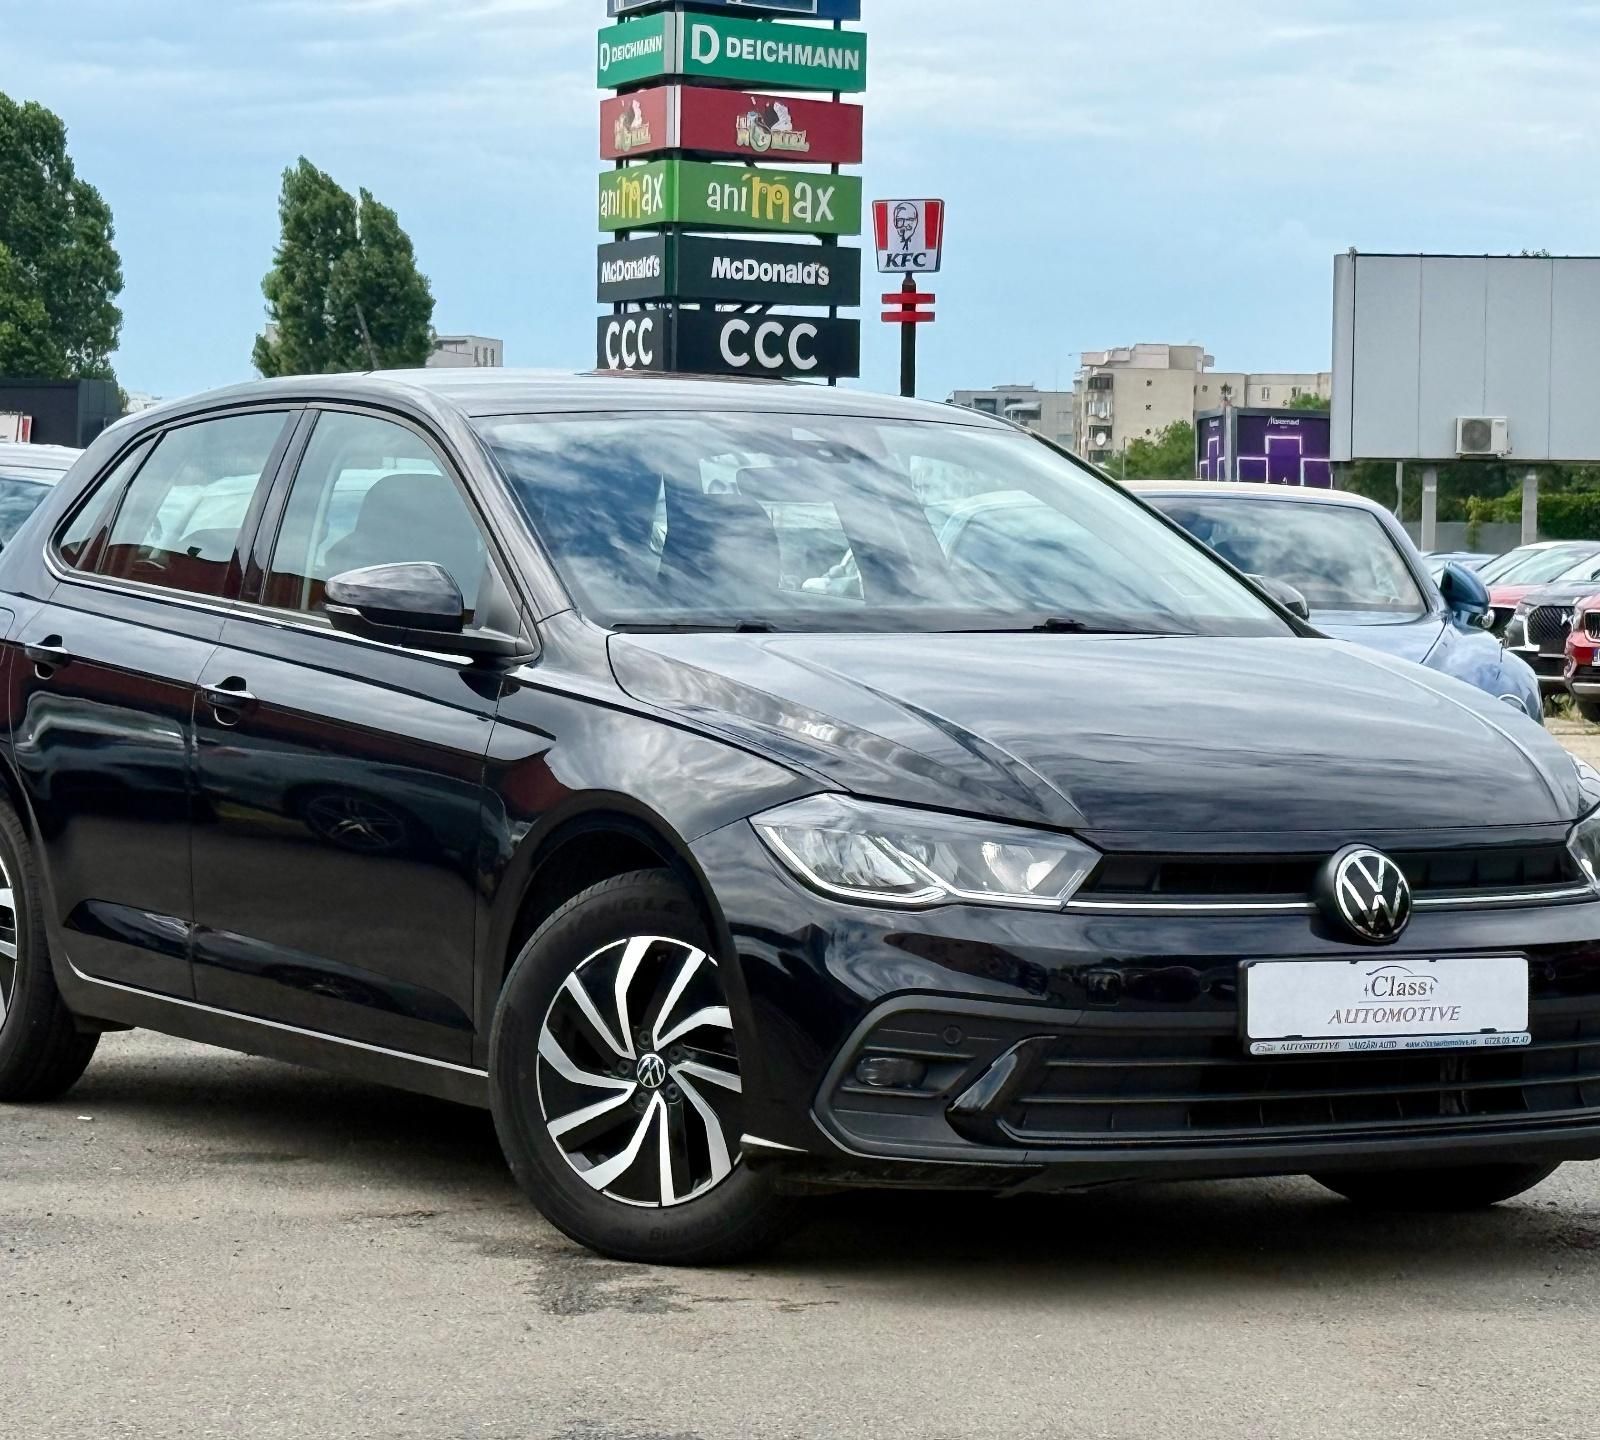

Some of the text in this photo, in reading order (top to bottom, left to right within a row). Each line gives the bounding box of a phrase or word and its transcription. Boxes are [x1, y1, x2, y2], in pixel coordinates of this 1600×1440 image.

[611, 34, 663, 63] DEICHMANN
[691, 24, 860, 71] D DEICHMANN
[600, 172, 664, 219] animax
[706, 173, 835, 223] animax
[601, 254, 660, 284] McDonald's
[711, 256, 830, 286] McDonald's
[884, 252, 927, 269] KFC
[605, 317, 653, 370] CCC
[720, 318, 818, 370] CCC
[1371, 976, 1427, 997] Class
[1327, 1005, 1462, 1025] AUTOMOTIVE
